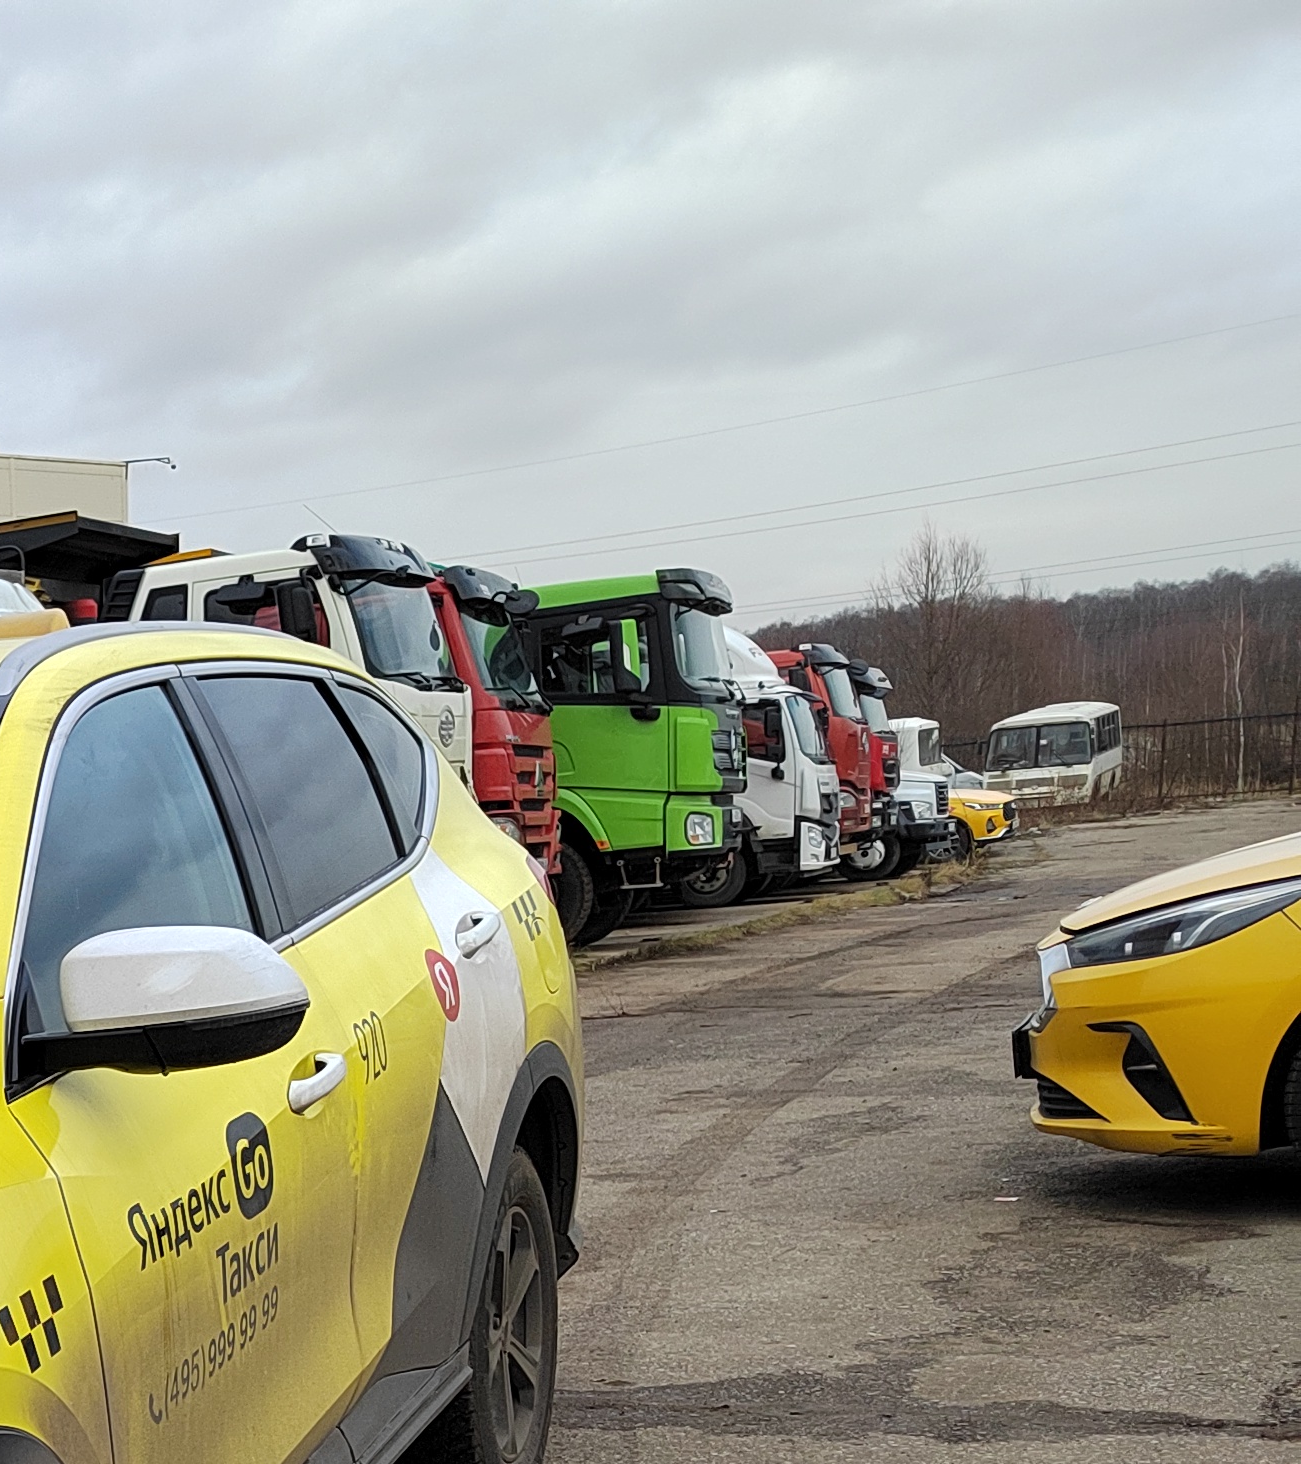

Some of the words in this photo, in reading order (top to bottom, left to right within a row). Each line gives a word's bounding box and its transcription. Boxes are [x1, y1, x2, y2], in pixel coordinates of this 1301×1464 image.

[433, 961, 457, 1010] Я
[352, 1010, 388, 1085] 920
[127, 1168, 231, 1272] Яндекс
[235, 1138, 270, 1200] Go
[215, 1222, 279, 1305] Такси
[208, 1322, 236, 1378] 999
[239, 1304, 257, 1347] 99
[261, 1285, 279, 1329] 99
